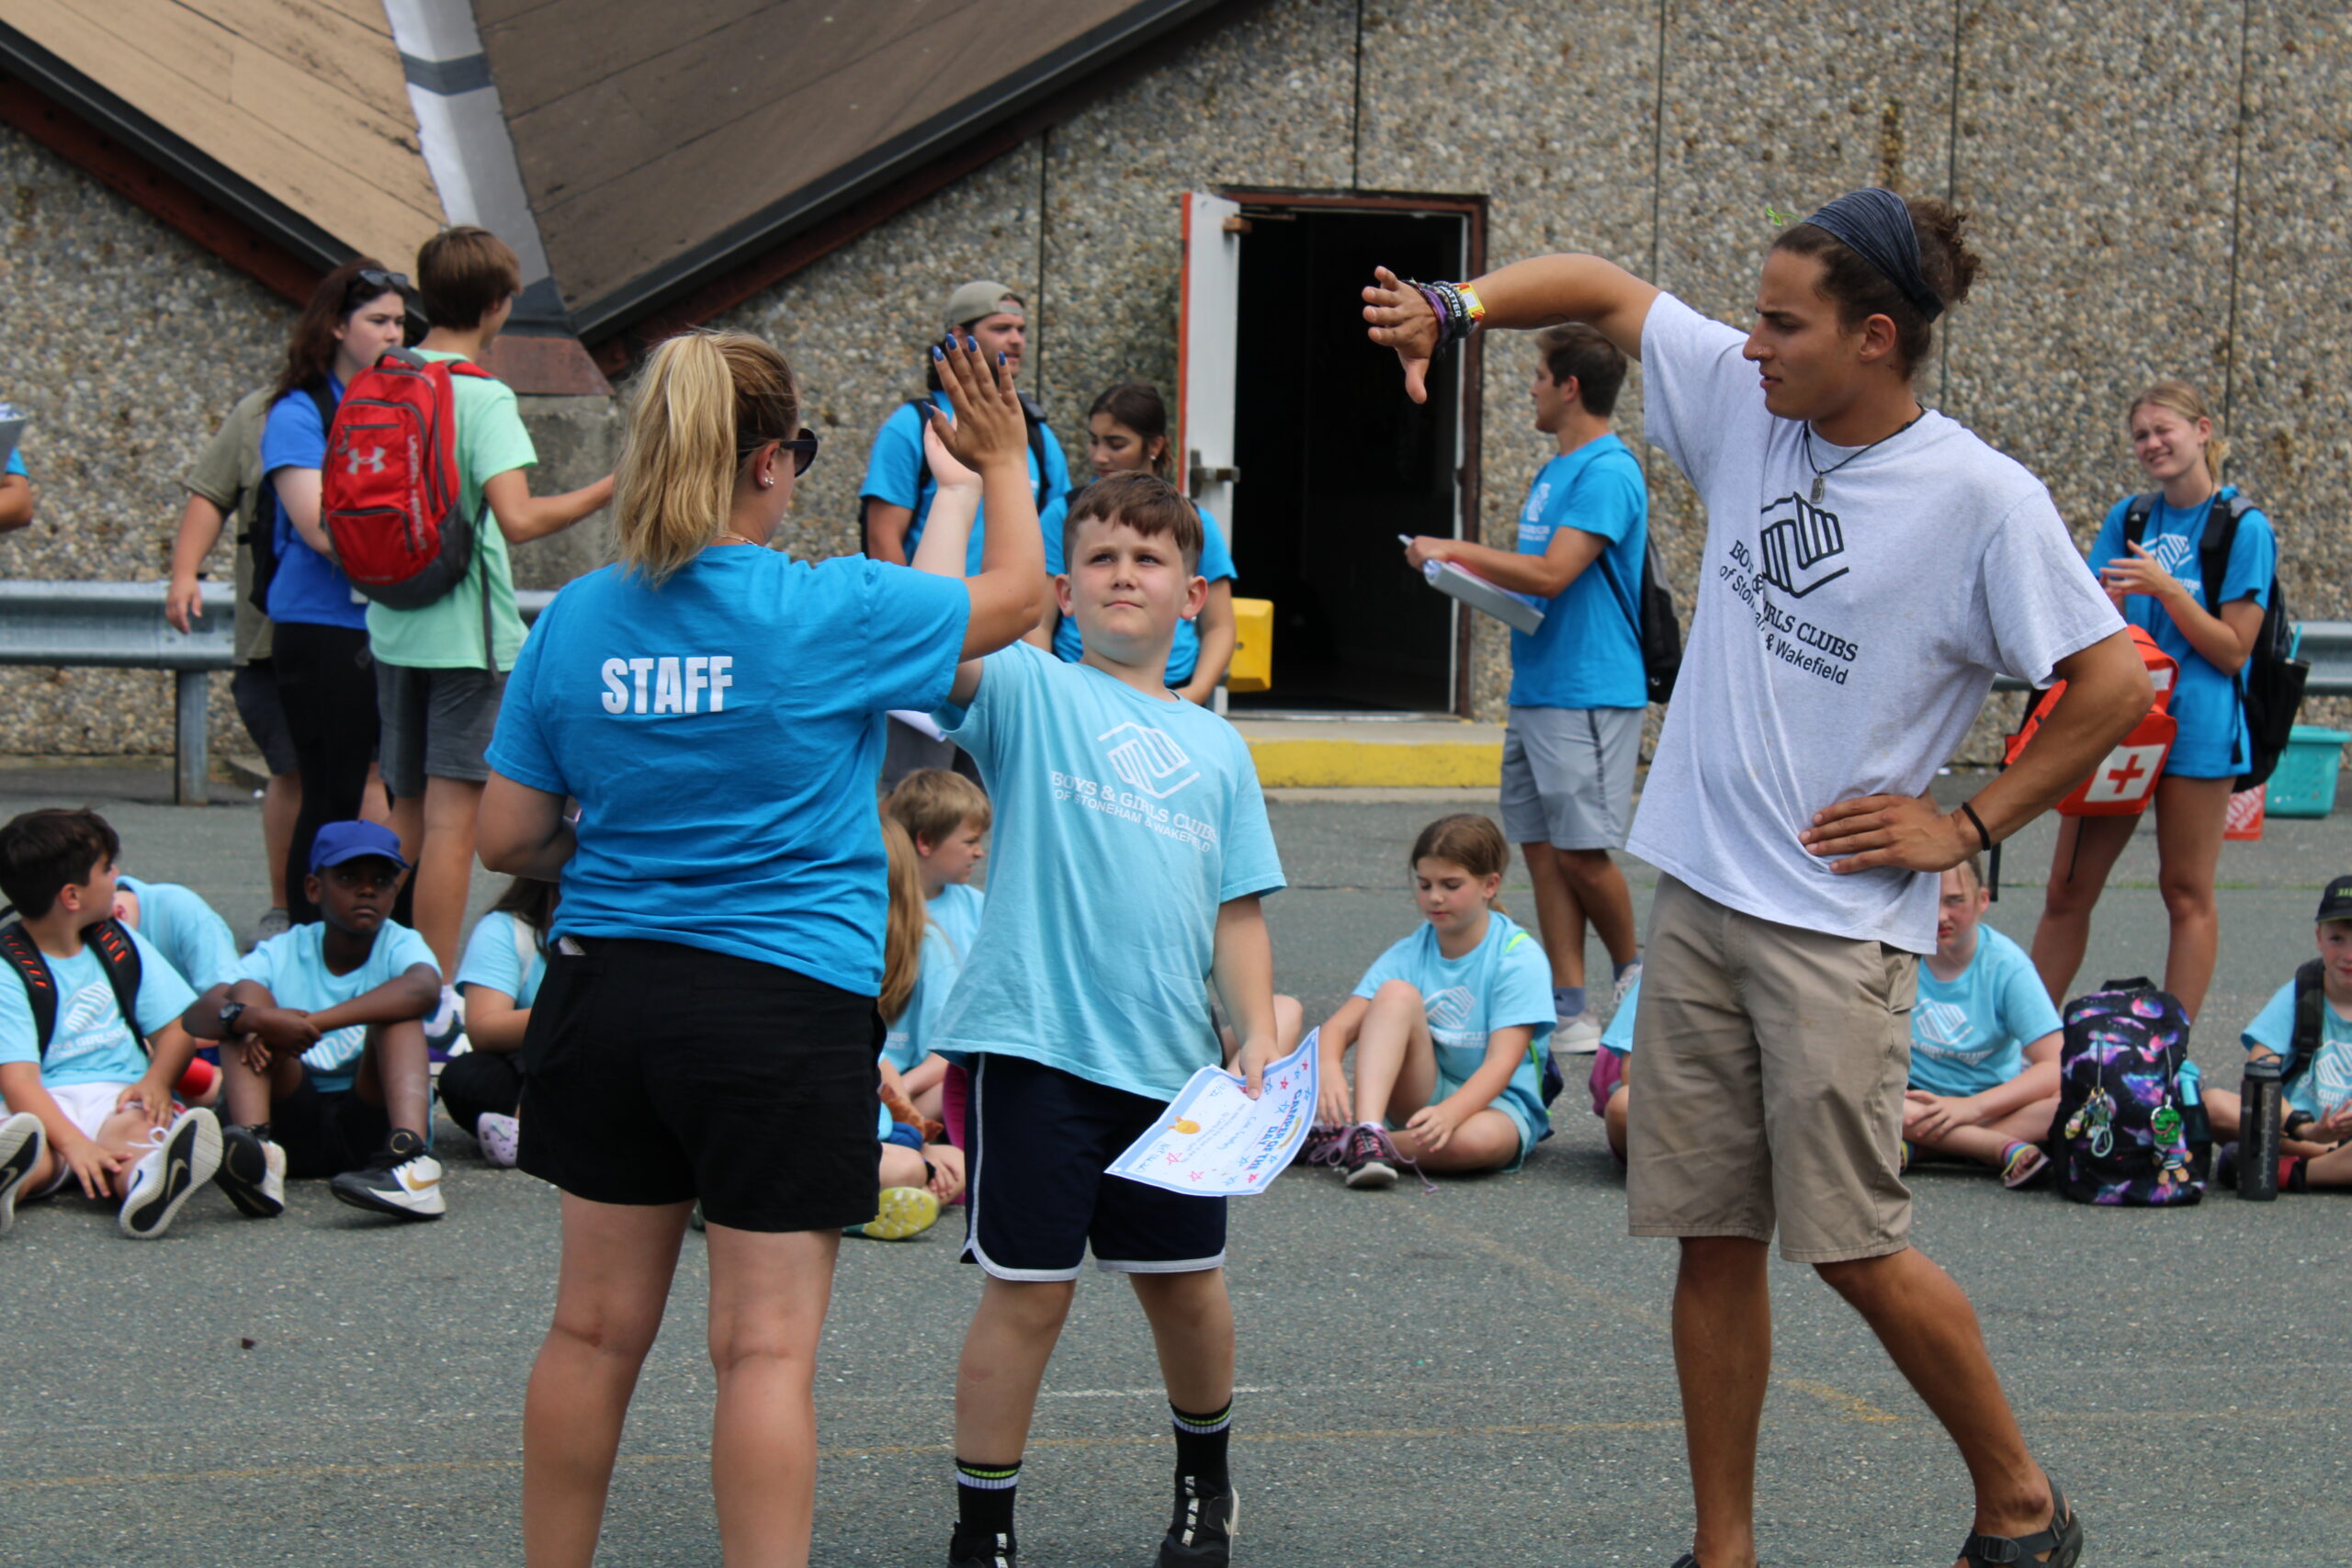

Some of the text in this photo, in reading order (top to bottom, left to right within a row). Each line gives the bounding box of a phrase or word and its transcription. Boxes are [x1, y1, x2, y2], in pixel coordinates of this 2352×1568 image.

[1719, 565, 1736, 581] of
[1765, 633, 1775, 651] &
[1775, 637, 1849, 685] Wakefield
[1752, 573, 1764, 595] &
[1796, 621, 1860, 662] CLUBS
[601, 656, 733, 715] STAFF
[1050, 770, 1098, 795] BOYS
[1100, 785, 1116, 802] &
[1120, 792, 1170, 823] GIRLS
[1054, 789, 1071, 801] OF
[1073, 793, 1143, 824] STONEHAM
[1144, 817, 1154, 829] &
[1258, 1126, 1279, 1145] DAY
[1276, 1089, 1302, 1140] CAMPER
